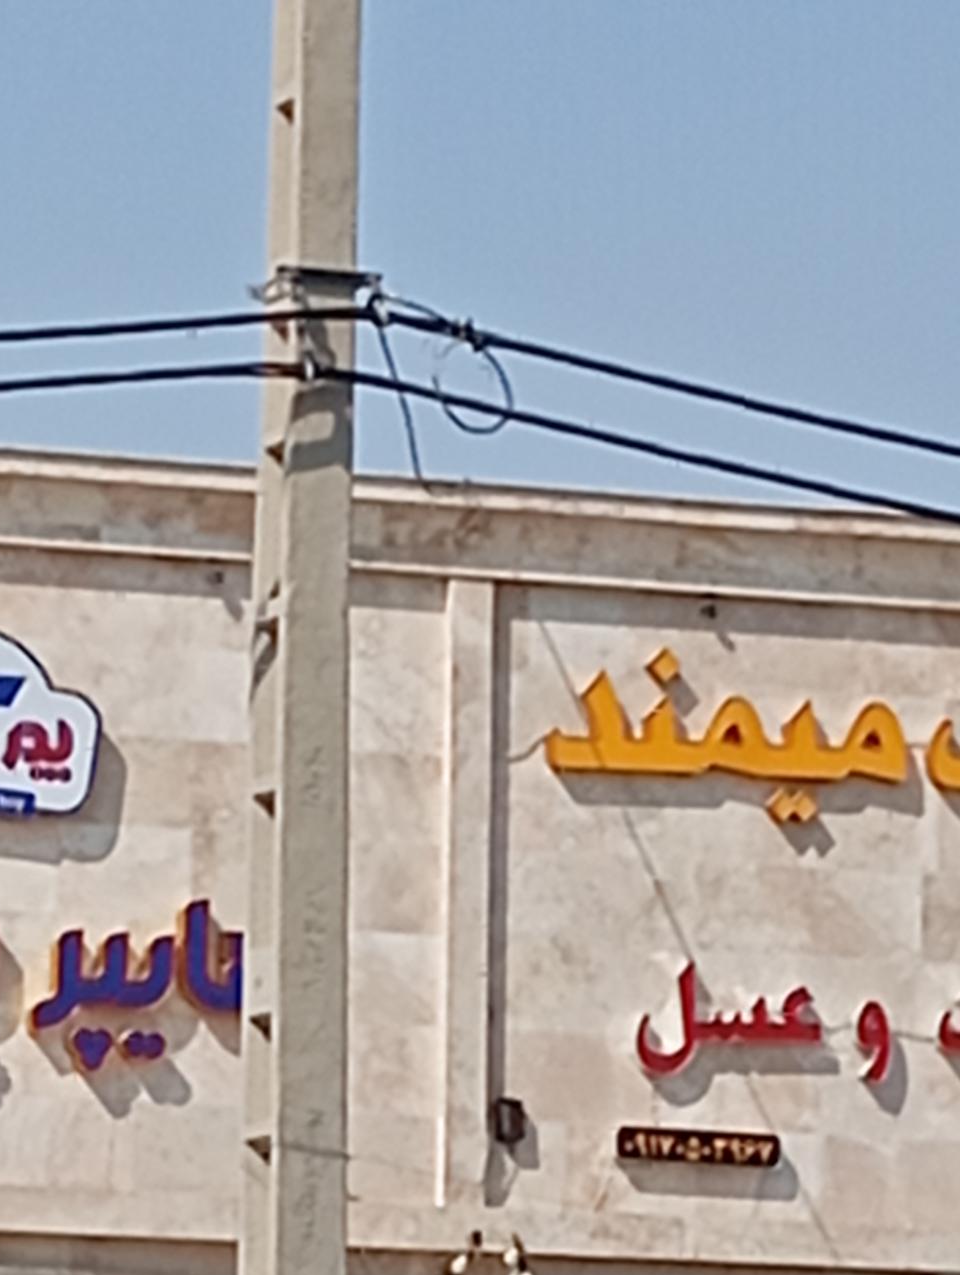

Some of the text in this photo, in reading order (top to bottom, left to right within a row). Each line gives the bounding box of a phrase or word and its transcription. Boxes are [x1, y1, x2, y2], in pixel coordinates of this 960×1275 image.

[545, 648, 908, 824] میمند
[636, 962, 823, 1076] عسل
[857, 1001, 892, 1082] و
